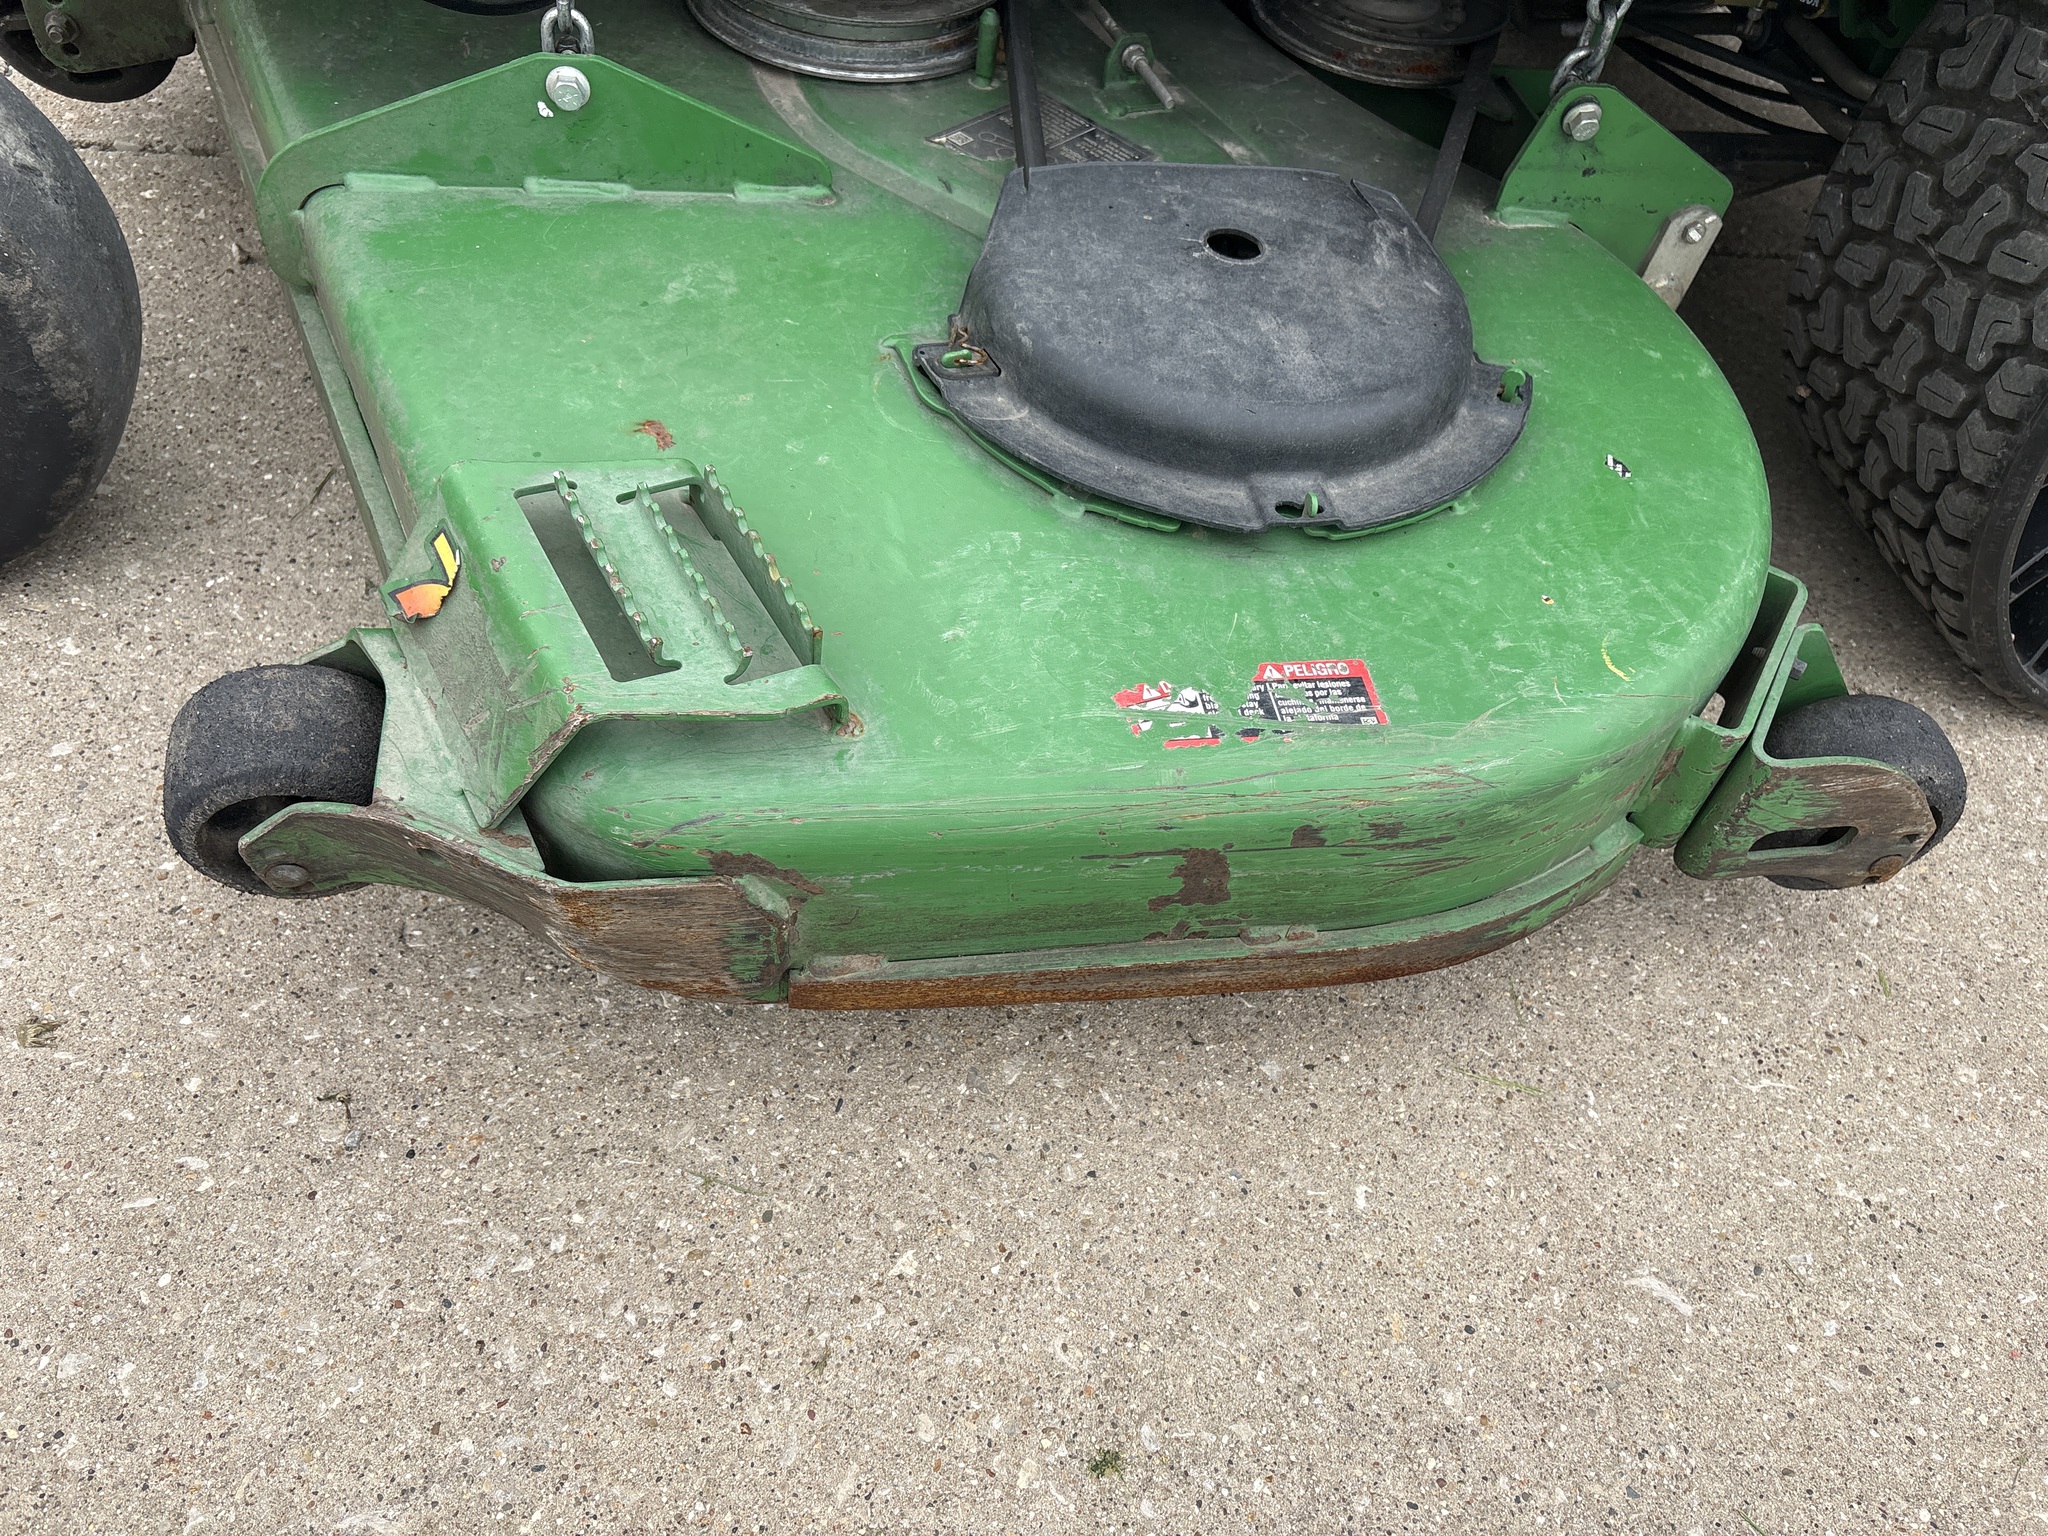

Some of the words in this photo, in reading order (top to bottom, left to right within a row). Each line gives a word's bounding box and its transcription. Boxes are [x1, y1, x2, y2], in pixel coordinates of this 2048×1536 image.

[1283, 662, 1350, 677] PELIGRO
[1293, 681, 1316, 689] evitar
[1316, 680, 1352, 689] lesiones
[1314, 690, 1328, 698] por
[1328, 688, 1343, 696] las
[1281, 706, 1313, 716] alejado
[1328, 703, 1354, 712] borde
[1355, 703, 1367, 711] de
